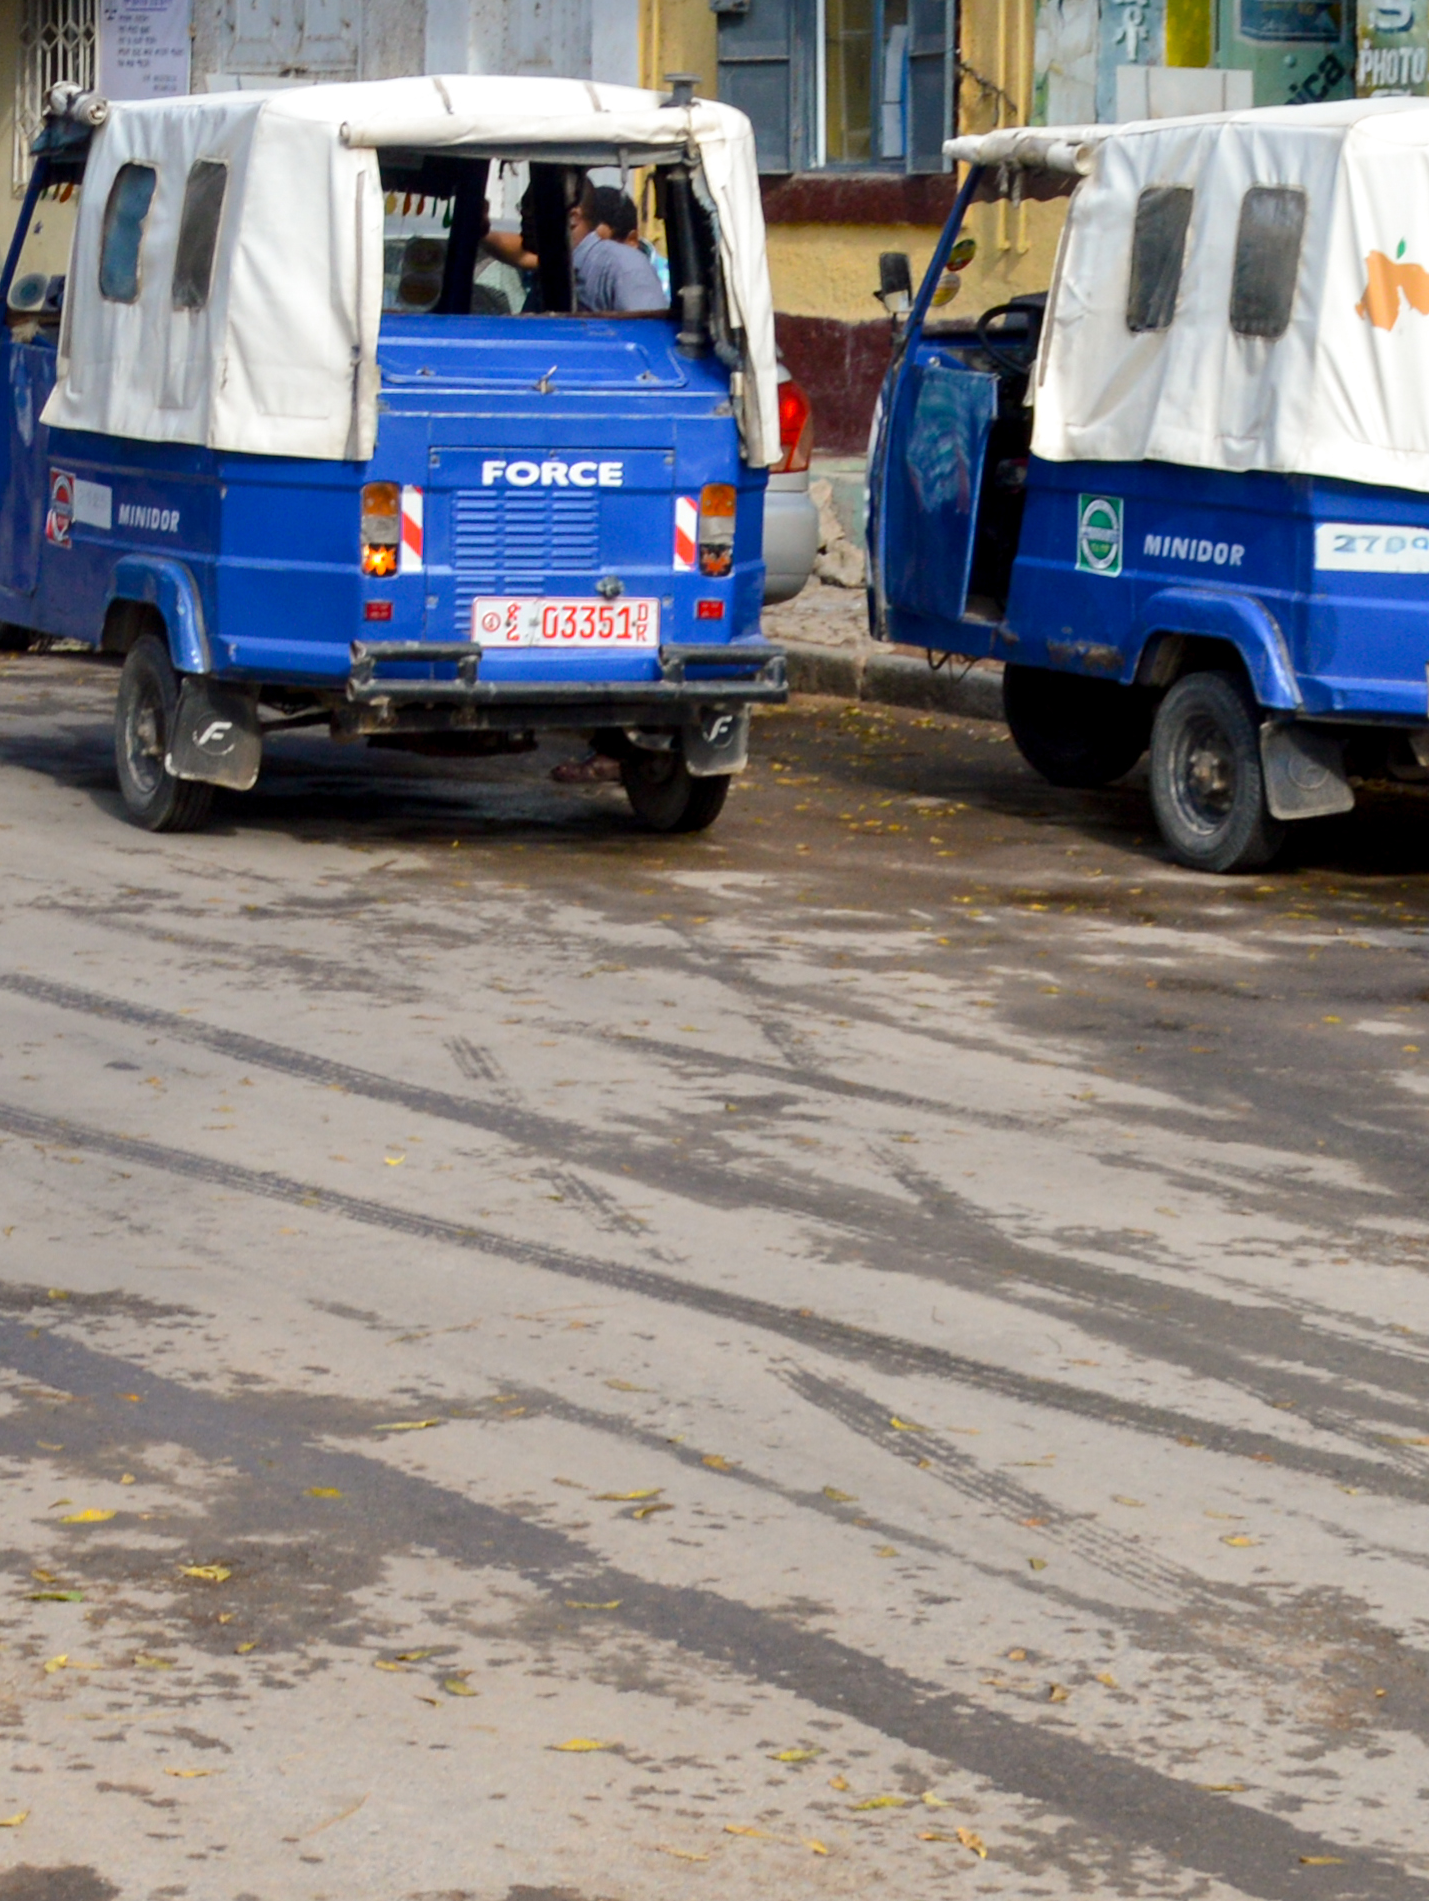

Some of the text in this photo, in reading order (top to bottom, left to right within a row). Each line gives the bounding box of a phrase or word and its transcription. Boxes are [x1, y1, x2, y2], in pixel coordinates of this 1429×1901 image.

[1358, 47, 1425, 85] PHOTO
[481, 460, 624, 488] FORCE
[118, 503, 181, 533] MINIDOR
[1143, 534, 1246, 567] MINIDOR
[541, 605, 632, 640] 03351
